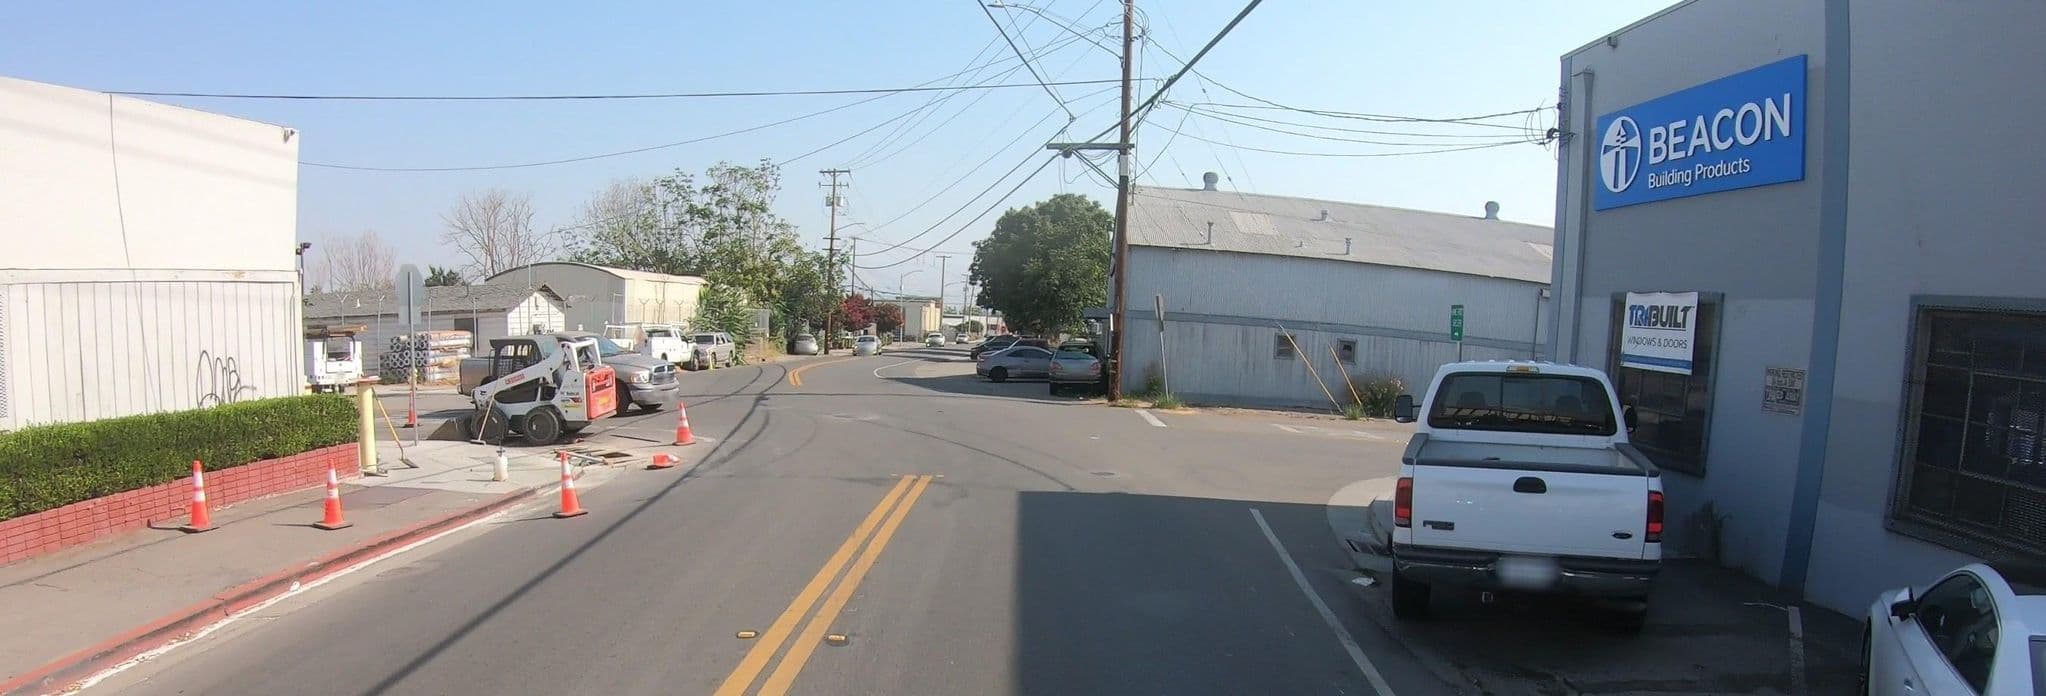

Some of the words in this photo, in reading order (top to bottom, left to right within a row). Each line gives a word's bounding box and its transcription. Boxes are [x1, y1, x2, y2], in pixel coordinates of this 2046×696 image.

[1649, 93, 1792, 165] BEACON
[1648, 168, 1692, 189] Building
[1695, 158, 1751, 182] Products
[1627, 335, 1656, 347] WINDOWS
[1663, 338, 1688, 349] DOORS
